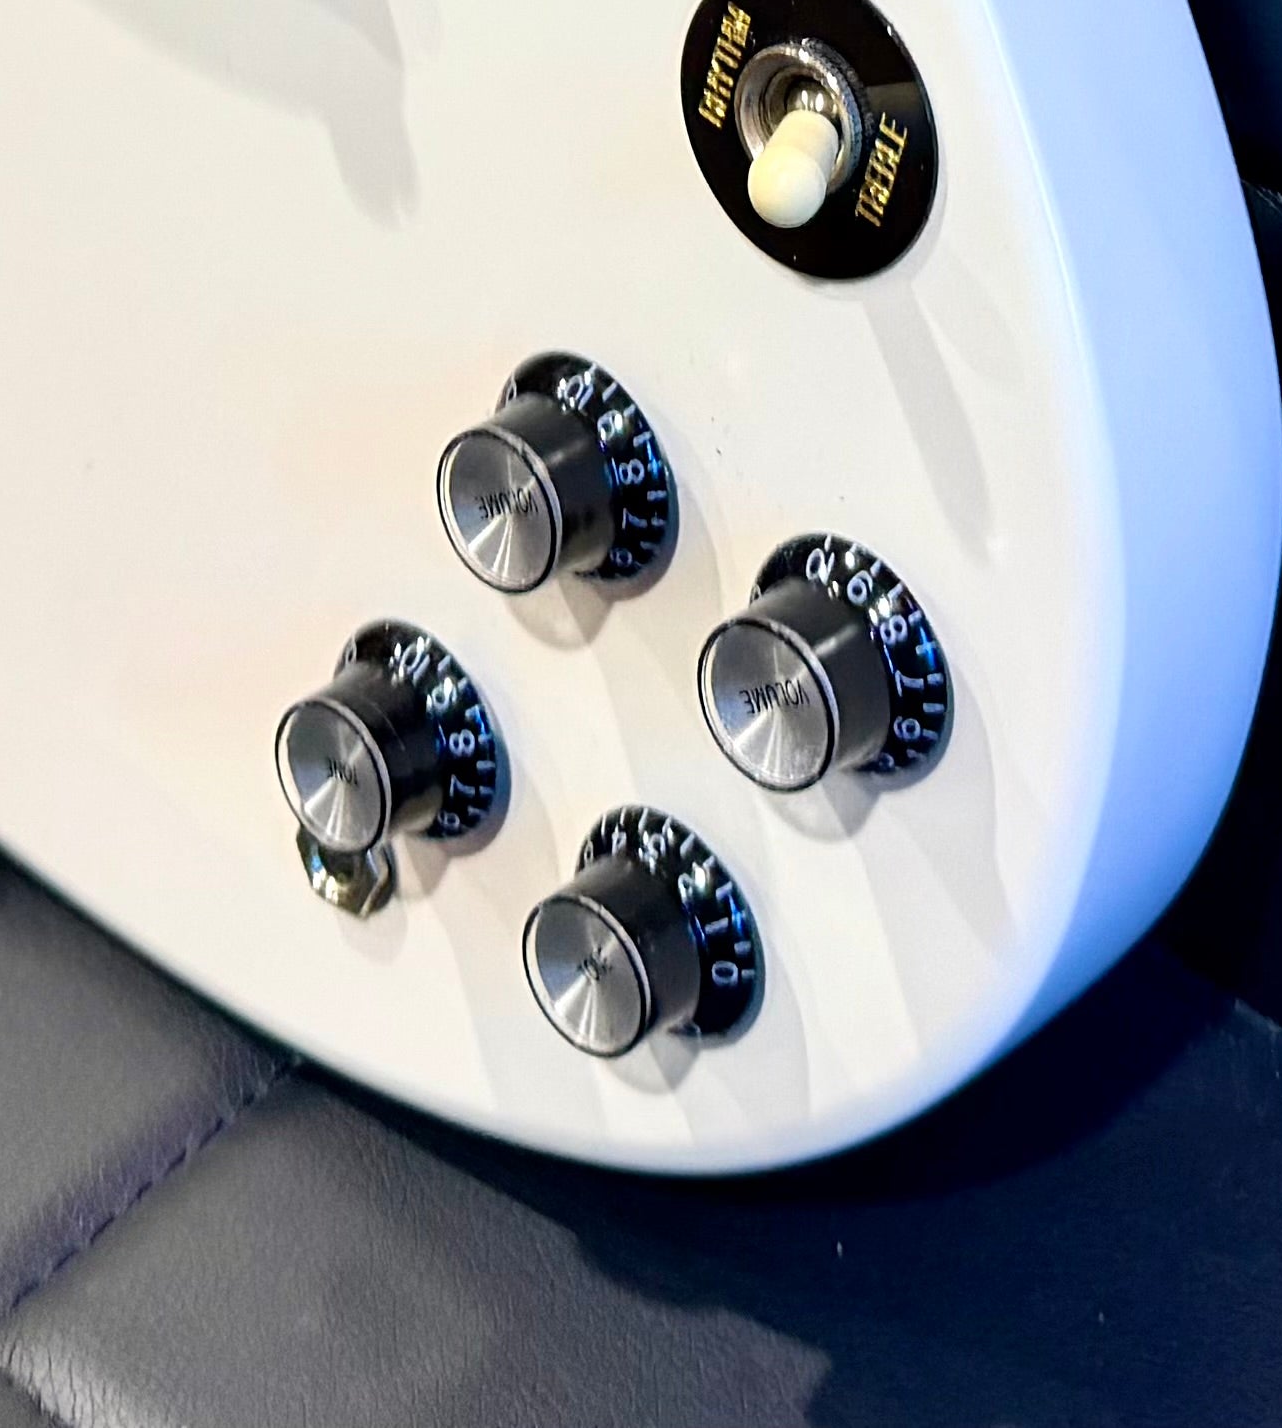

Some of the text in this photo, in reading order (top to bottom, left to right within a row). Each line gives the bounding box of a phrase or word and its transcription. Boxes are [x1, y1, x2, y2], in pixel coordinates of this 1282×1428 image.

[855, 112, 908, 228] TREBLE
[618, 458, 645, 486] 8
[478, 489, 539, 520] VOLUME
[880, 614, 908, 645] 8
[739, 678, 811, 716] VOLUME
[894, 670, 924, 697] 7
[448, 728, 476, 757] 8
[893, 715, 921, 741] 6
[449, 774, 476, 798] 7
